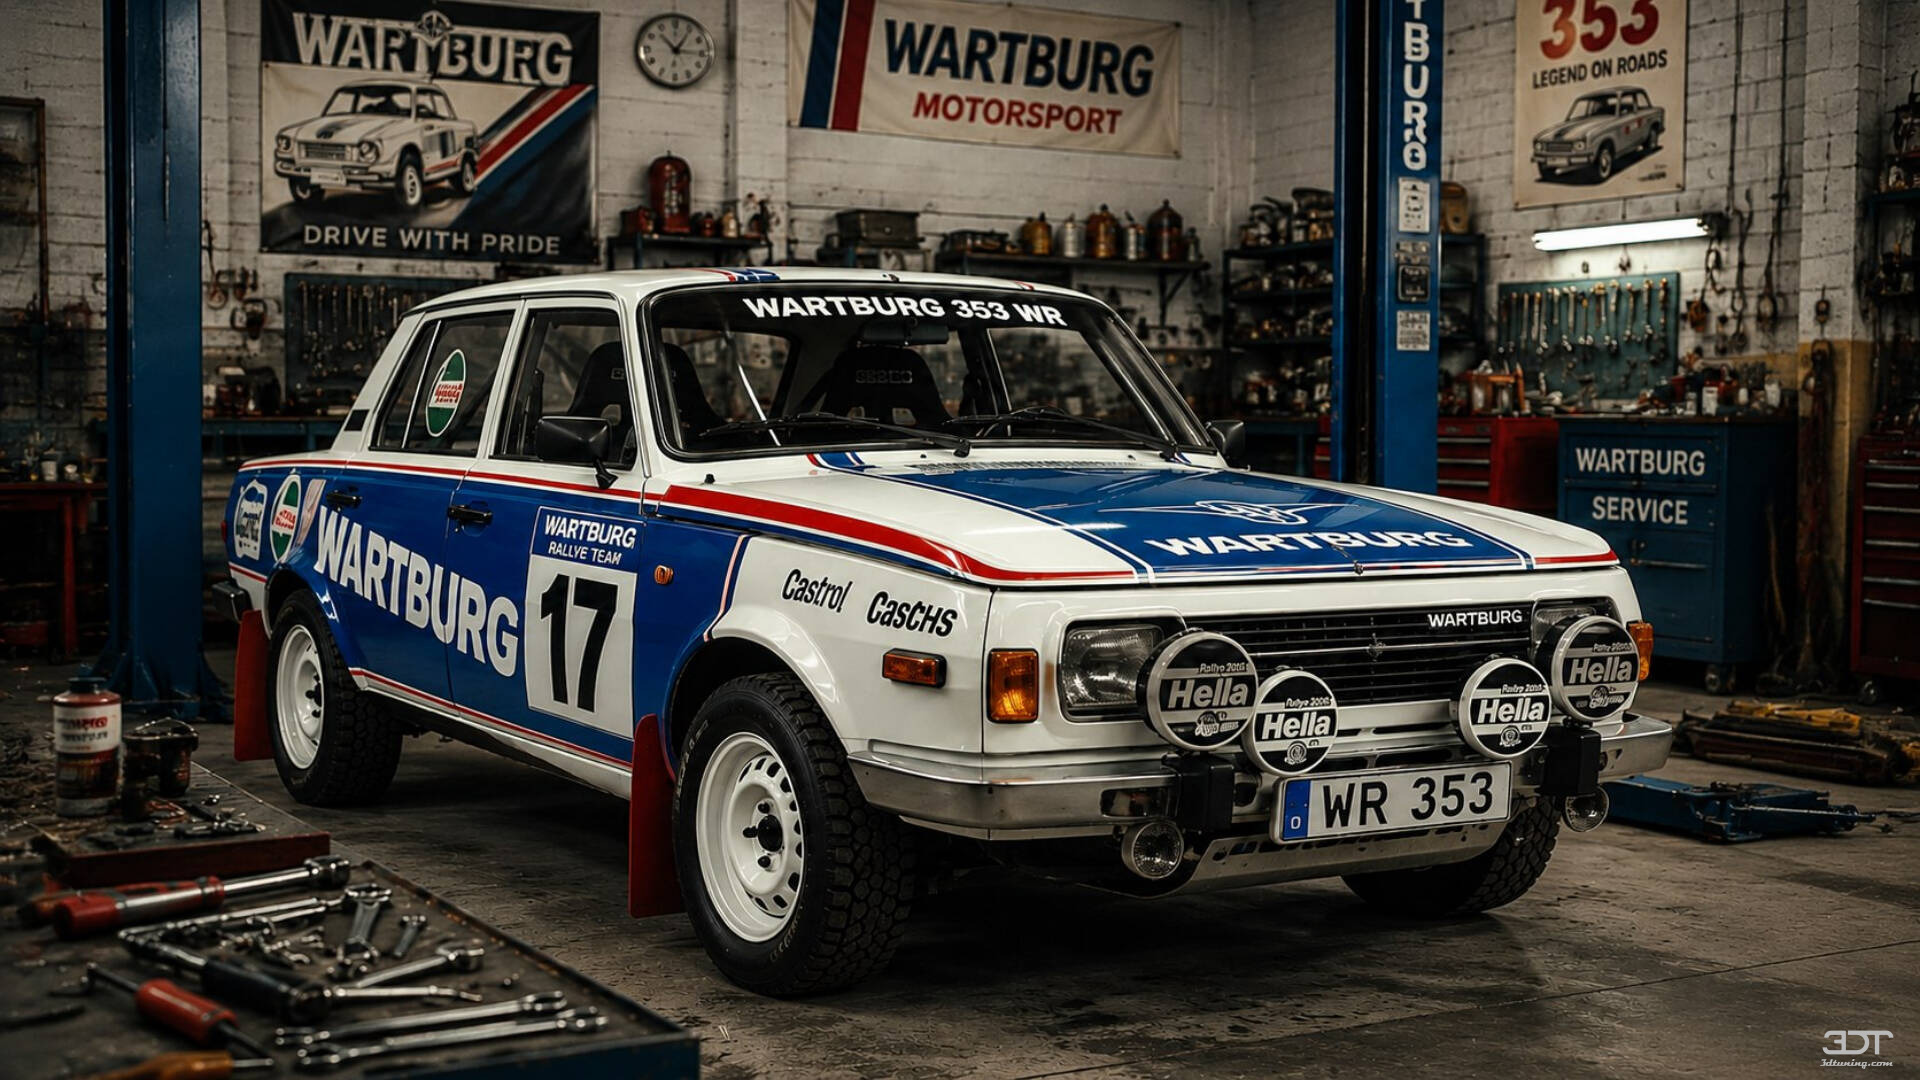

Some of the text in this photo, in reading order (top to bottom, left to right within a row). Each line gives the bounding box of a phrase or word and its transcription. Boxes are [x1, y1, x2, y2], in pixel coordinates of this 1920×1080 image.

[292, 12, 573, 87] WARTBURG
[884, 18, 1155, 97] WARTBURG
[1532, 49, 1668, 90] LEGEND ON ROADS
[912, 92, 1123, 134] MOTORSPORT
[303, 225, 561, 255] DRIVE WITH PRIDE
[743, 296, 1068, 327] WARTBURG 353 WR
[1575, 448, 1706, 476] WARTBURG
[1592, 496, 1689, 525] SERVICE
[544, 514, 637, 549] WARTBURG
[1144, 531, 1474, 557] WARTBURG
[548, 541, 622, 565] RALLYE TEAM
[313, 504, 520, 677] WARTBURG
[782, 568, 853, 613] Castrol
[1427, 609, 1523, 628] WARTBURG
[541, 573, 618, 713] 17
[1568, 656, 1632, 684] Hella
[1167, 677, 1248, 709] Hella
[1261, 711, 1331, 740] Hella
[1477, 697, 1545, 724] Hella
[1322, 771, 1493, 829] WR 353
